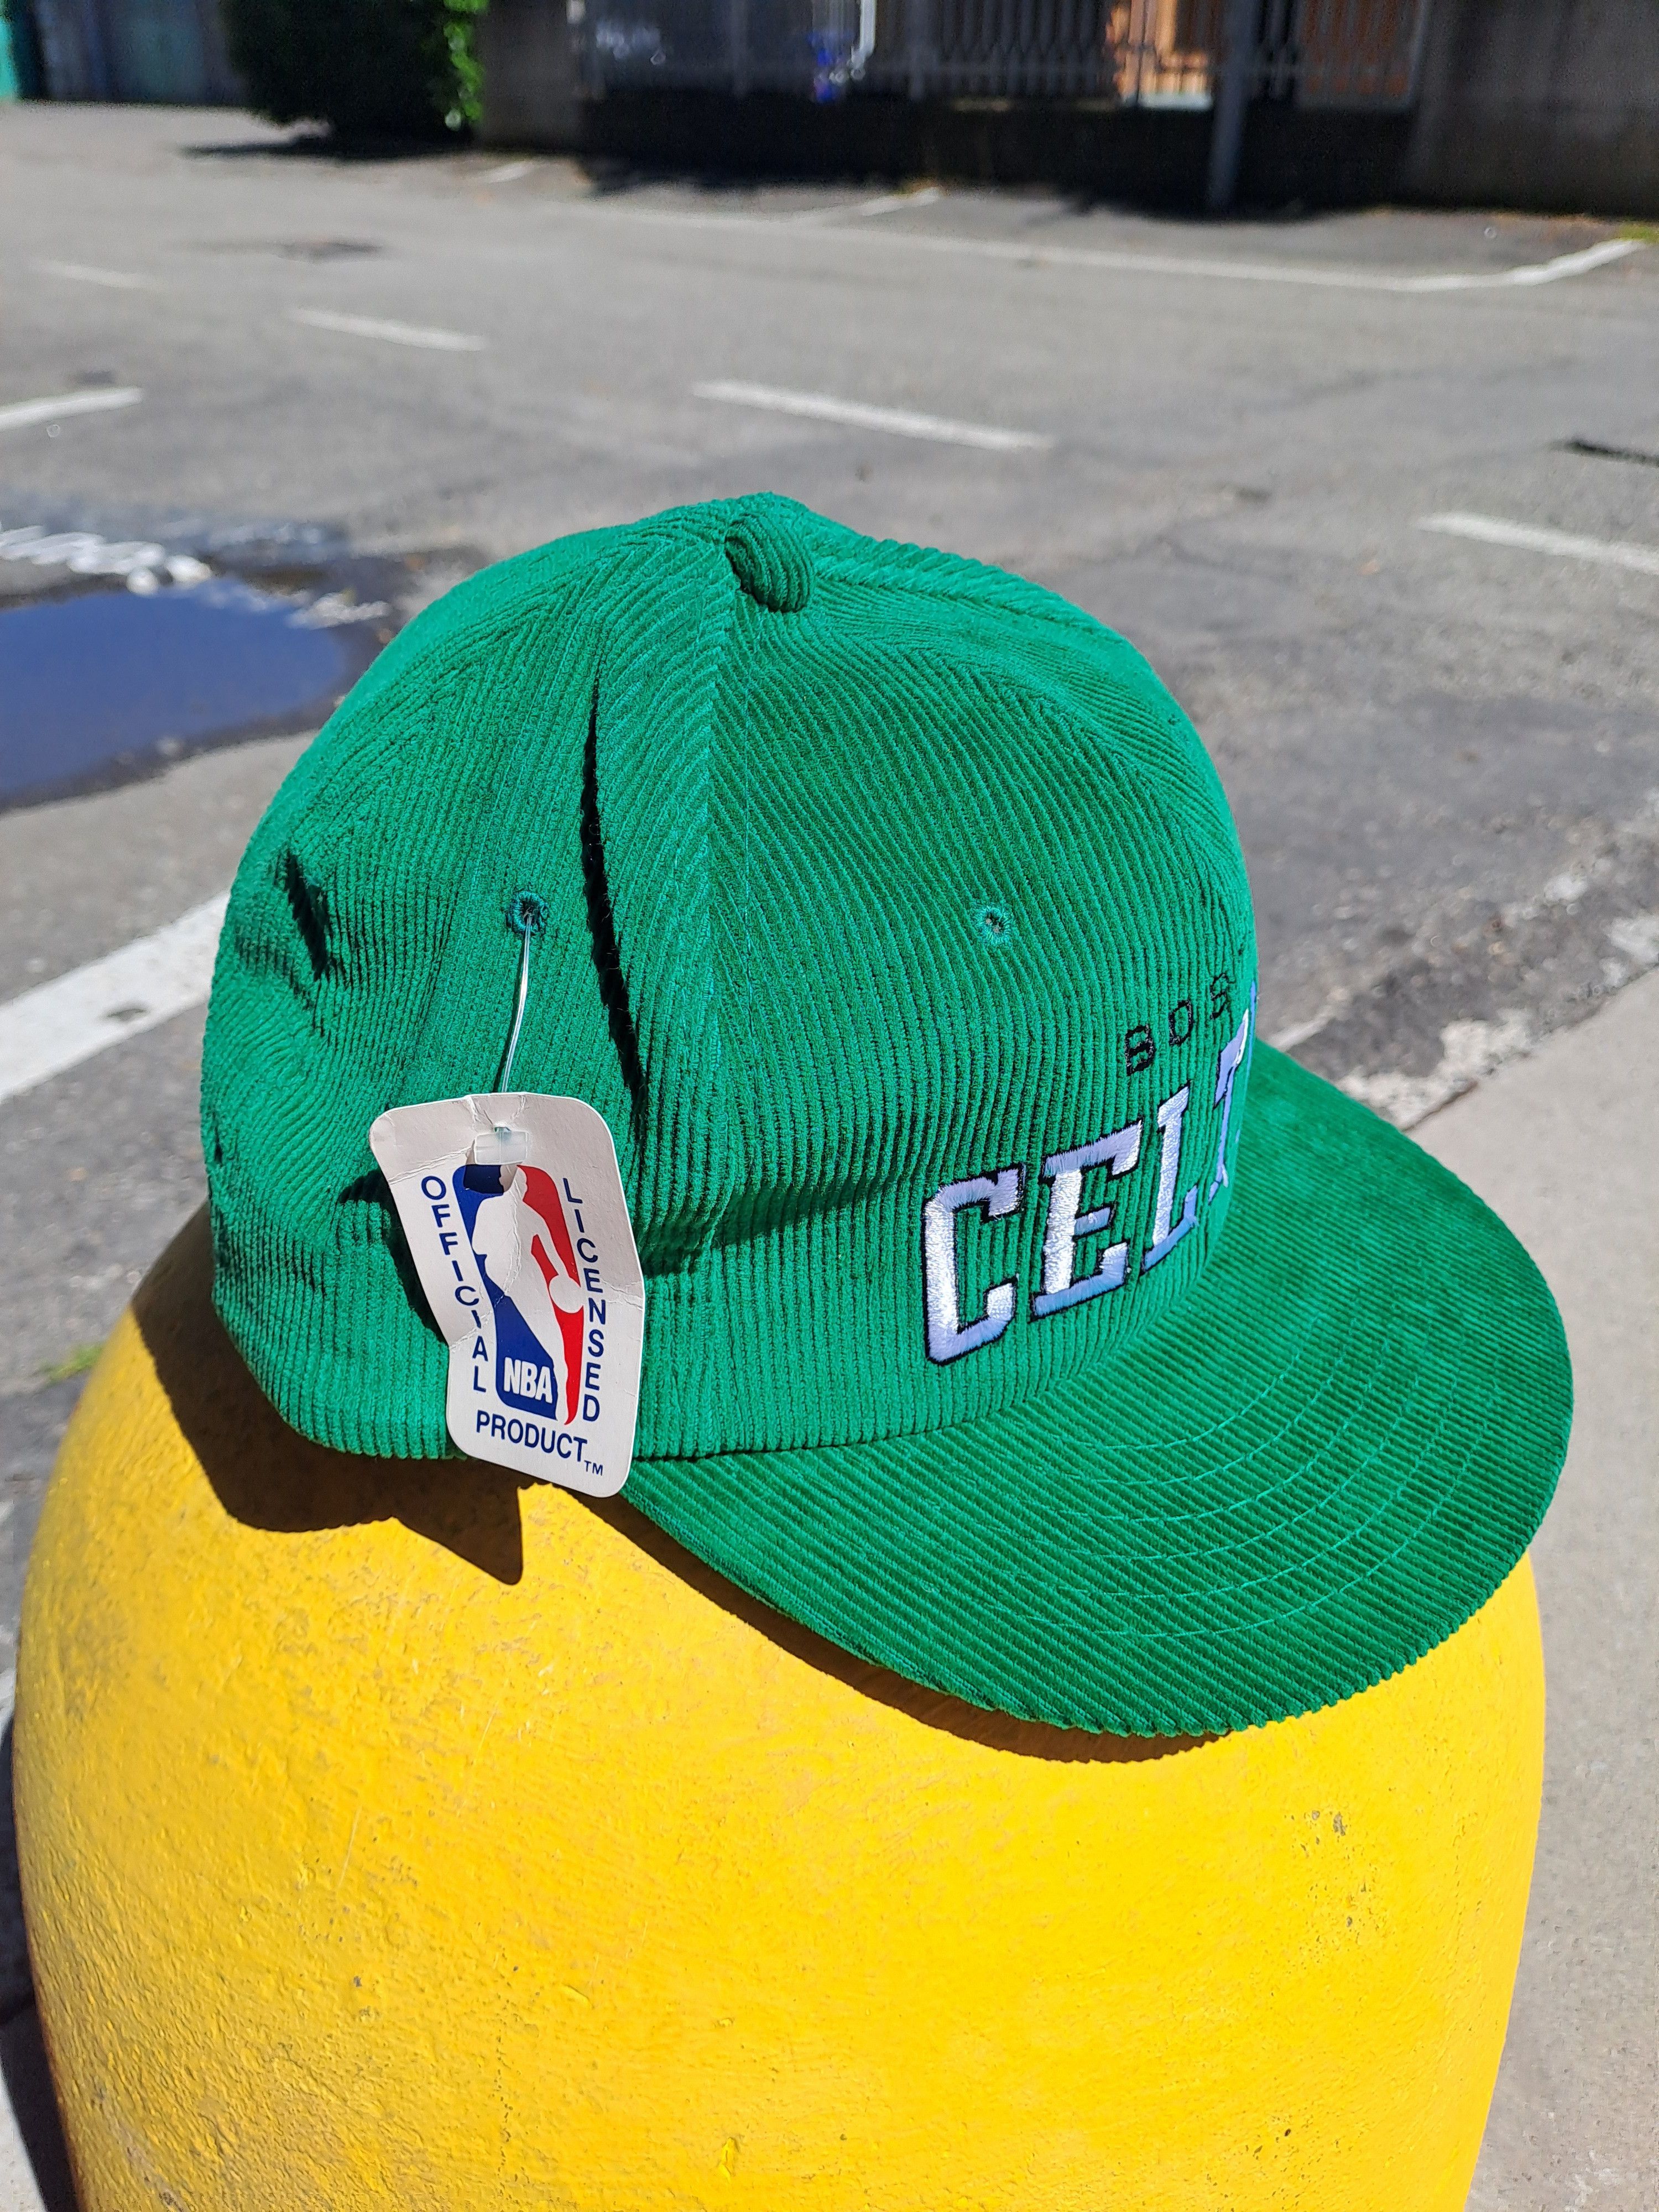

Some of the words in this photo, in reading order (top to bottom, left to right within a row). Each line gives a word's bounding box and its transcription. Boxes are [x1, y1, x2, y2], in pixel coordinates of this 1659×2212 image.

[1125, 942, 1245, 1076] BOS
[922, 979, 1256, 1364] CELT
[421, 1176, 488, 1393] OFFICIAL
[503, 1356, 553, 1404] NBA
[563, 1178, 607, 1422] LICENSED
